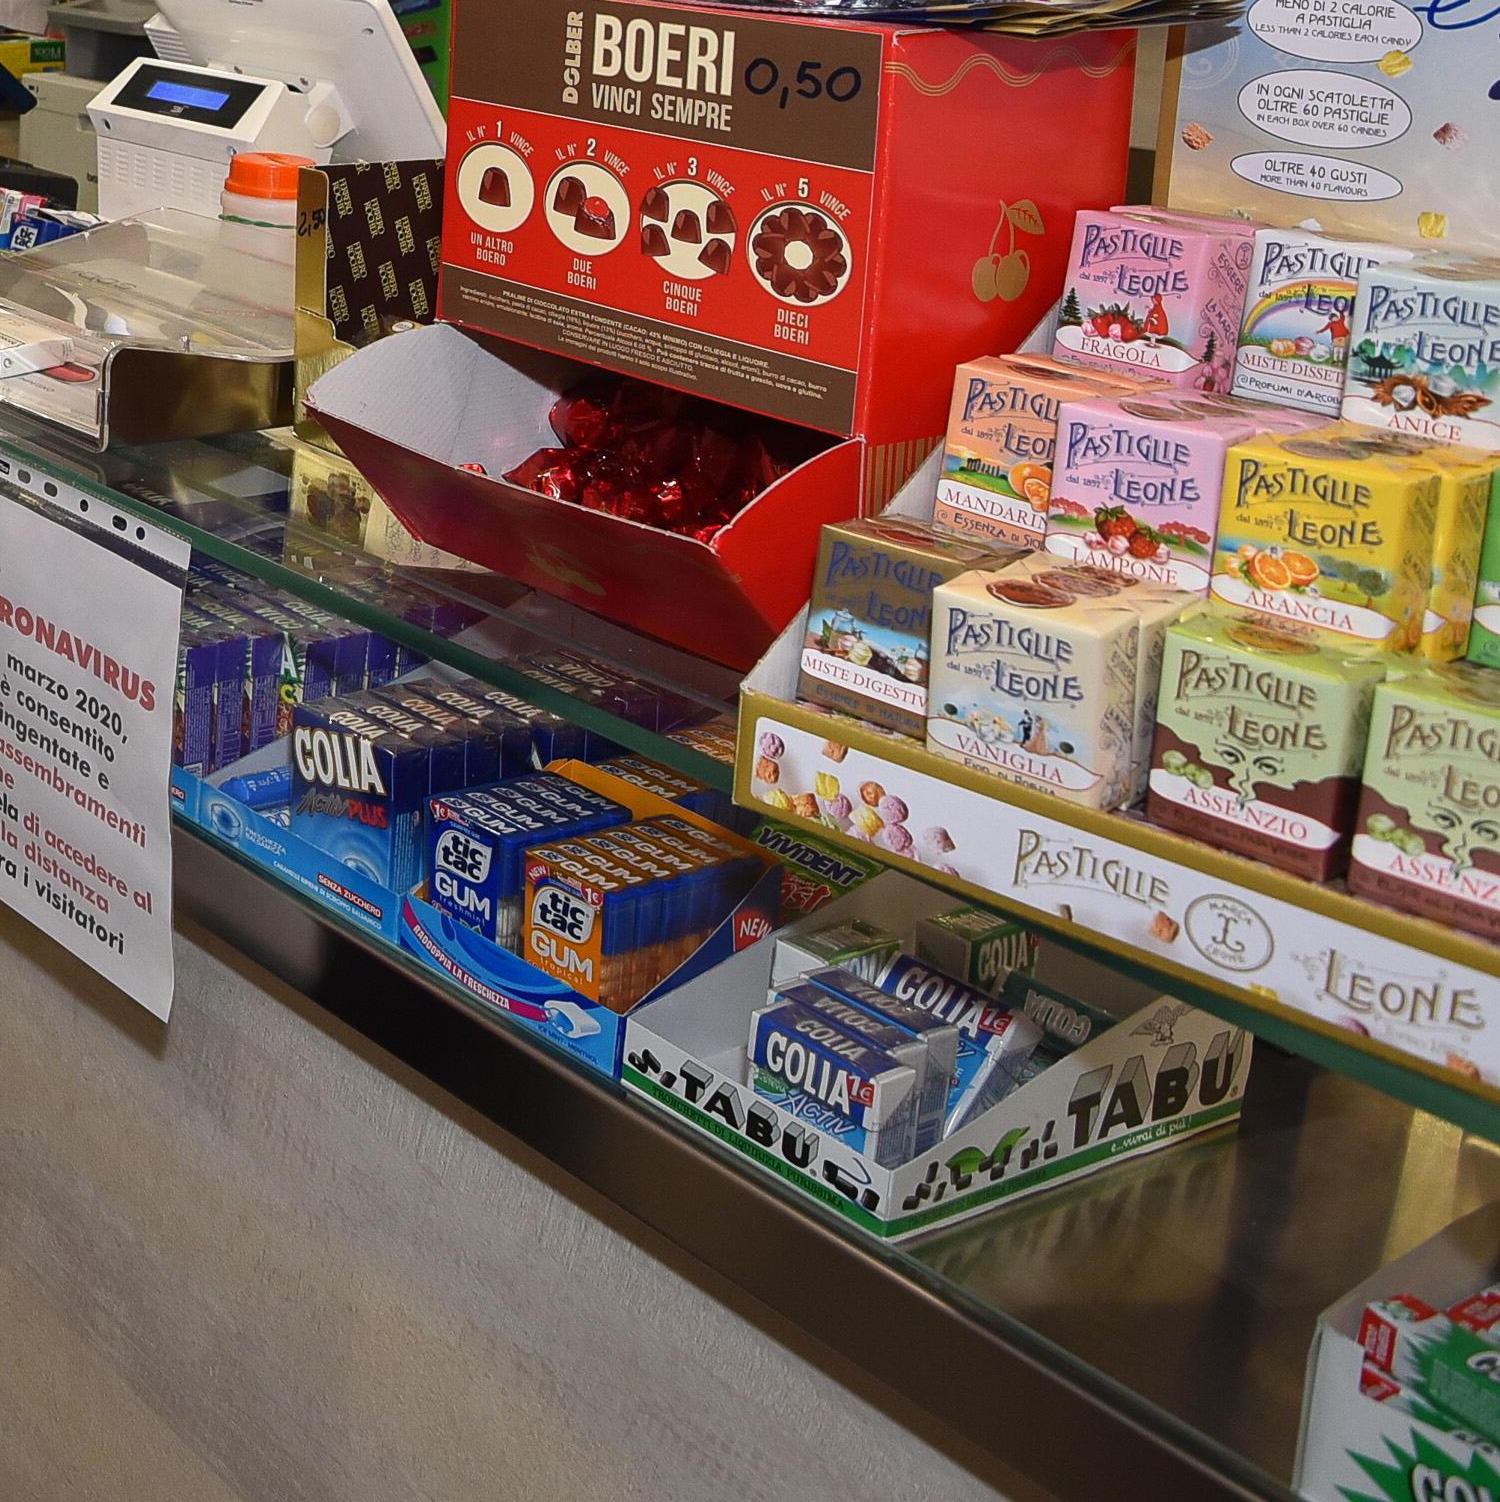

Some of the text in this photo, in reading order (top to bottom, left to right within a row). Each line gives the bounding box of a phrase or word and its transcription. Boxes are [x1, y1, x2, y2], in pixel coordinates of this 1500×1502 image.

[1296, 13, 1372, 31] A PASTIGLIA
[1313, 0, 1326, 11] DI
[1330, 1, 1338, 13] 2
[1342, 2, 1397, 19] CALORIE
[592, 13, 737, 97] BOERI
[591, 82, 733, 133] VINCI SEMPRE
[1264, 159, 1368, 185] OLTRE 40 GUSTI
[470, 232, 514, 254] UN ALTRO
[476, 248, 507, 267] BOERO
[1080, 224, 1185, 270] PASTIGLIE
[567, 270, 597, 291] BOERI
[572, 256, 593, 274] DUE
[1116, 263, 1190, 298] LEONE
[662, 280, 702, 303] CINQUE
[665, 296, 699, 318] BOERI
[773, 323, 810, 346] BOERI
[776, 308, 809, 328] DIECI
[1080, 335, 1163, 369] FRAGOLA
[1386, 411, 1463, 443] ANICE
[1071, 544, 1178, 586] LAMPONE
[1243, 587, 1355, 634] ARANCIA
[7, 653, 69, 701] marzo
[75, 689, 127, 744] 2020,
[1, 674, 11, 696] è
[16, 690, 115, 763] consentito
[956, 729, 1065, 787] VANIGLIA
[98, 772, 110, 790] e
[346, 798, 389, 829] PLUS
[23, 812, 40, 837] di
[45, 829, 128, 897] accedere
[134, 890, 153, 914] al
[450, 833, 484, 861] tic
[1, 820, 18, 850] la
[24, 841, 110, 914] distanza
[441, 852, 482, 881] tac
[24, 866, 29, 887] i
[35, 879, 124, 955] visitatori
[317, 874, 382, 919] SENZA ZUCCHERO
[435, 871, 491, 921] GUM
[738, 917, 772, 940] NEW
[1011, 827, 1486, 1030] PASTIGLIE LEONE
[1068, 1032, 1245, 1148] TABU
[677, 1059, 819, 1169] TABU
